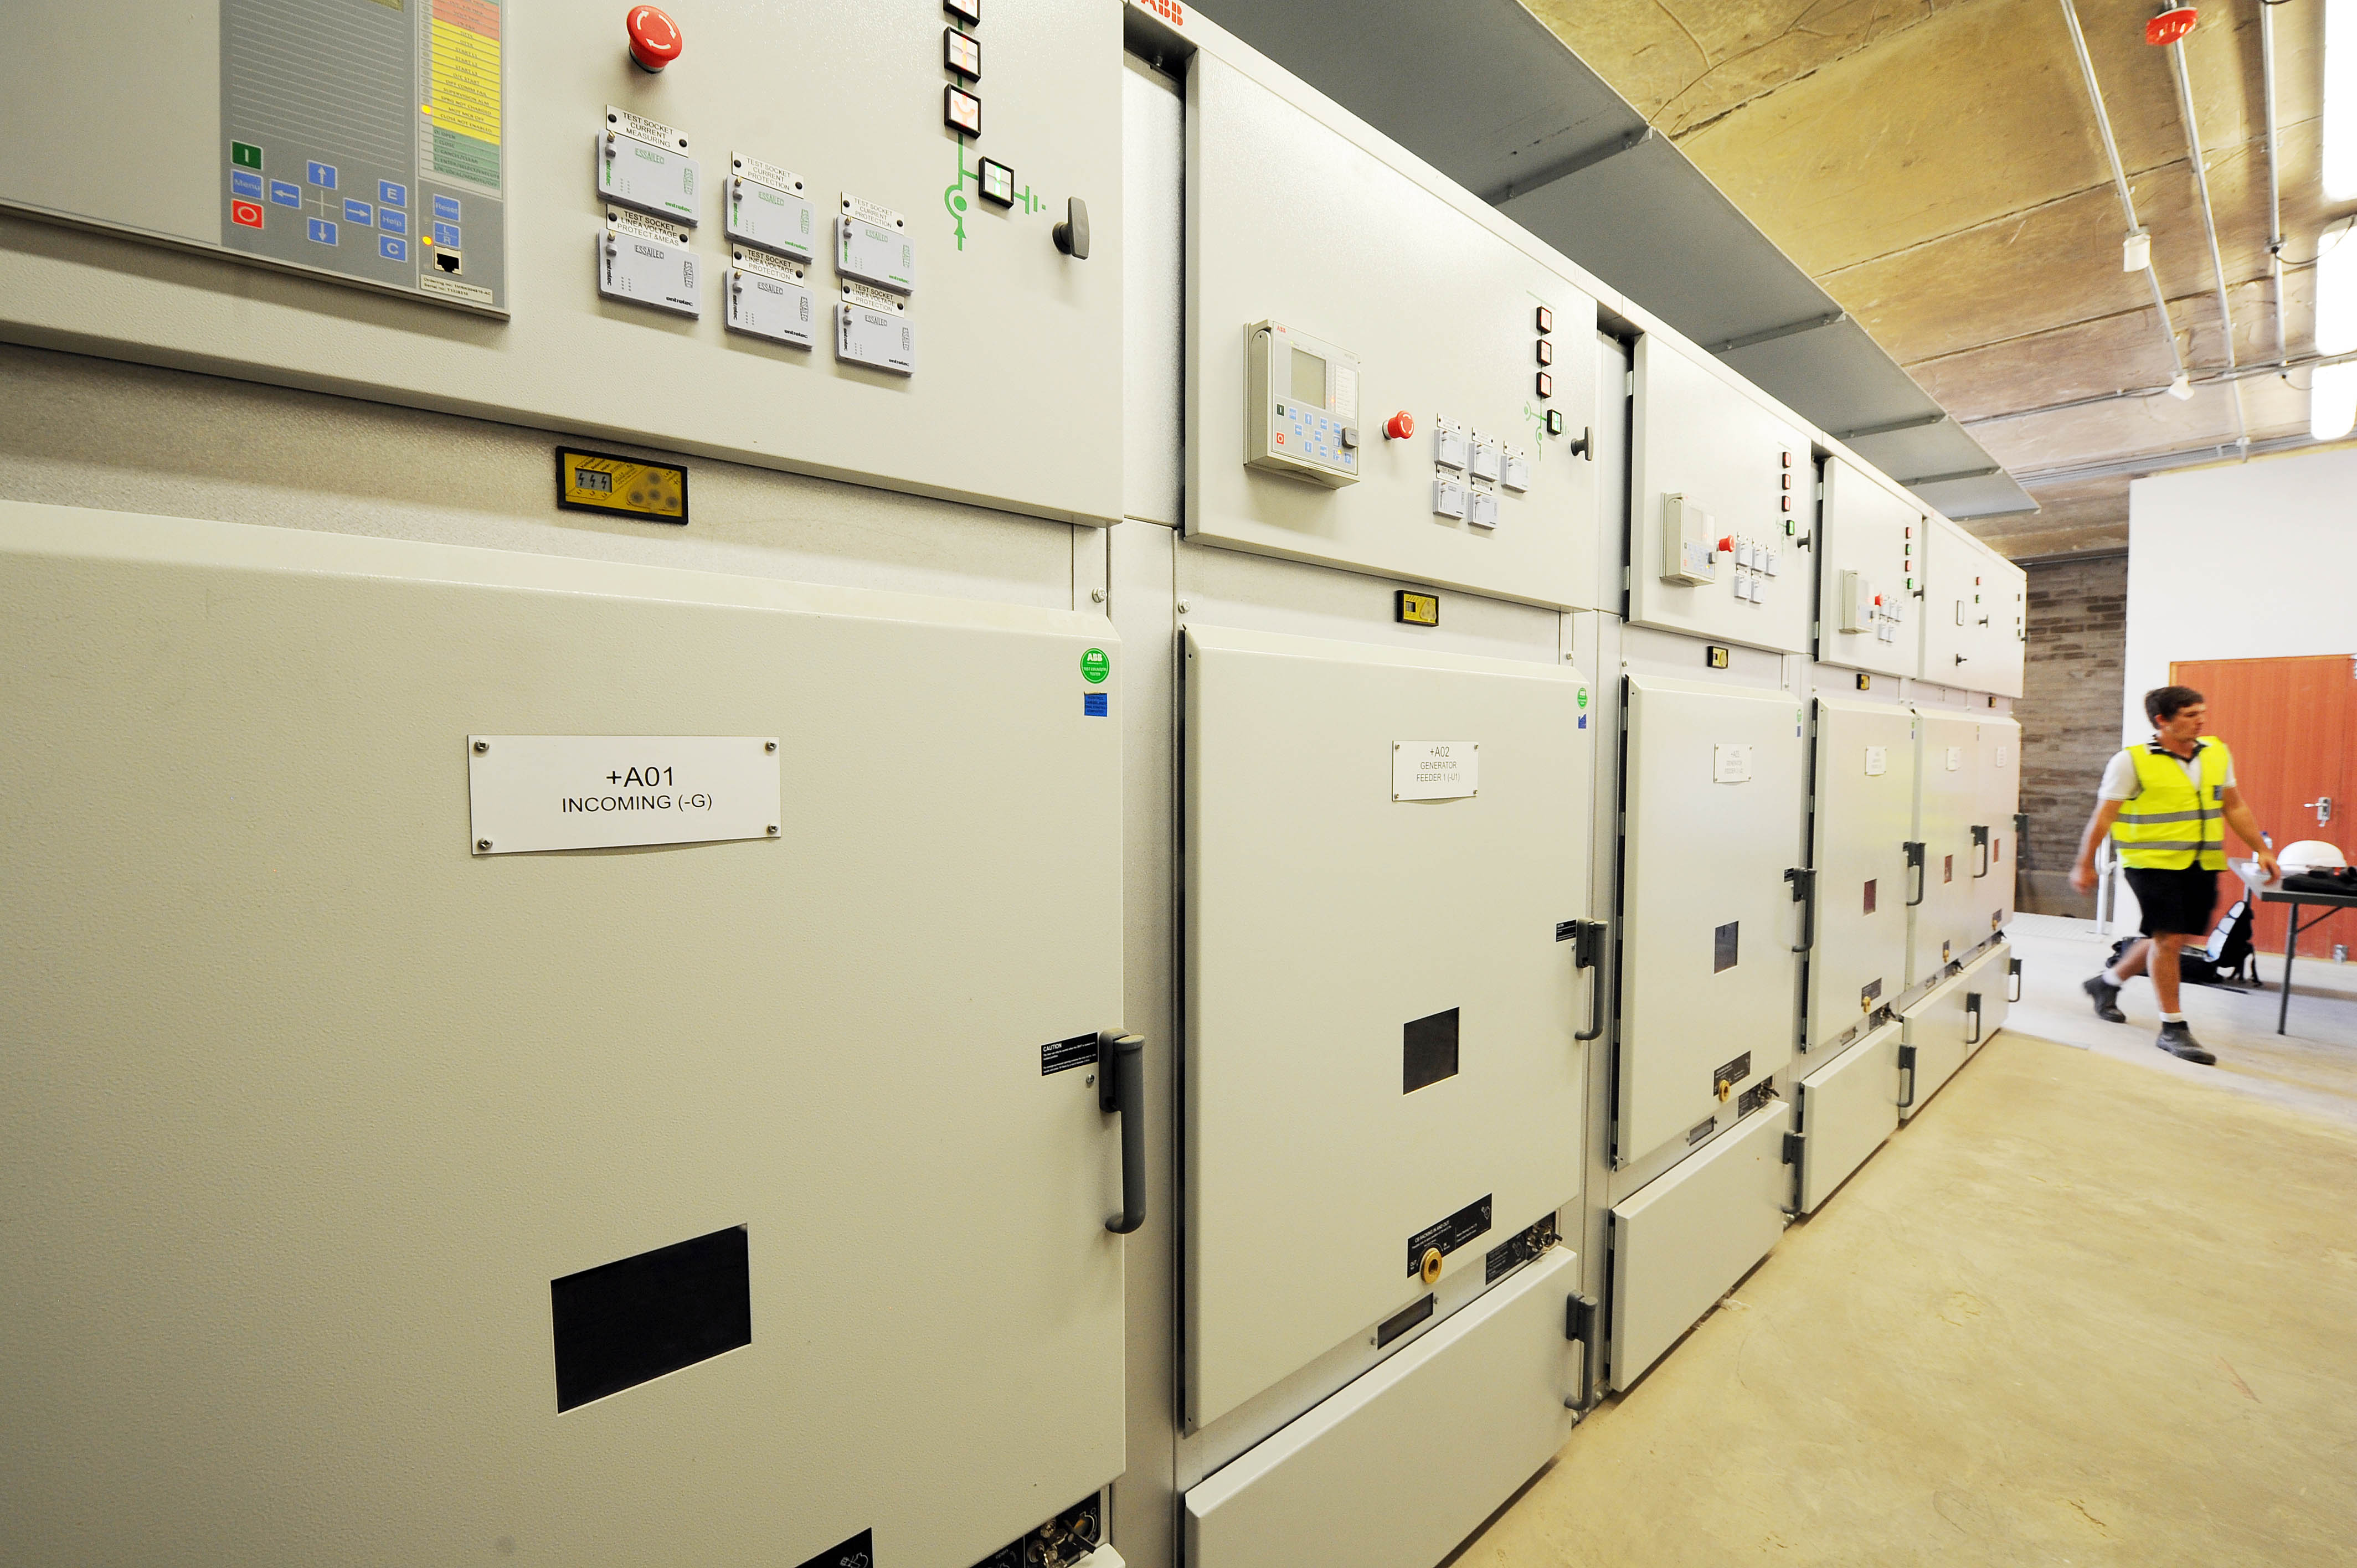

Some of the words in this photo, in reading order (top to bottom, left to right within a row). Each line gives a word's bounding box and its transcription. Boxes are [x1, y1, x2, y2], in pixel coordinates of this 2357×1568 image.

[622, 111, 642, 123] TEST
[644, 118, 673, 135] SOCKET
[630, 122, 666, 139] CURRENT
[626, 127, 671, 148] MEASURING
[747, 157, 763, 169] TEST
[765, 163, 791, 178] SOCKET
[753, 167, 785, 182] CURRENT
[234, 178, 260, 191] Menu
[748, 172, 790, 191] PROTECTION
[387, 187, 398, 200] E
[435, 201, 459, 214] Reset
[855, 198, 868, 208] TEST
[870, 203, 893, 216] SOCKET
[860, 207, 887, 220] CURRENT
[382, 215, 402, 227] Help
[621, 216, 643, 228] LINEA
[644, 224, 678, 238] VOLTAGE
[624, 211, 643, 222] TEST
[645, 216, 675, 231] SOCKET
[855, 210, 892, 229] PROTECTION
[443, 225, 450, 234] L
[444, 236, 451, 245] R
[387, 243, 399, 255] C
[634, 244, 665, 260] ESSAILEC
[745, 255, 764, 265] LINEA
[764, 261, 794, 275] VOLTAGE
[748, 249, 764, 260] TEST
[765, 255, 792, 267] SOCKET
[749, 264, 791, 280] PROTECTION
[852, 289, 869, 298] LINEA
[869, 295, 896, 307] VOLTAGE
[855, 283, 869, 293] TEST
[871, 288, 894, 300] SOCKET
[856, 297, 893, 312] PROTECTION
[1277, 325, 1286, 334] ABB
[1087, 653, 1103, 661] ABB
[1429, 746, 1450, 757] +A02
[1420, 761, 1457, 770] GENERATOR
[606, 766, 673, 788] +A01
[1417, 773, 1442, 782] FEEDER
[562, 794, 672, 813] INCOMING
[678, 793, 713, 812] (-G)
[1043, 1043, 1062, 1052] CAUTION
